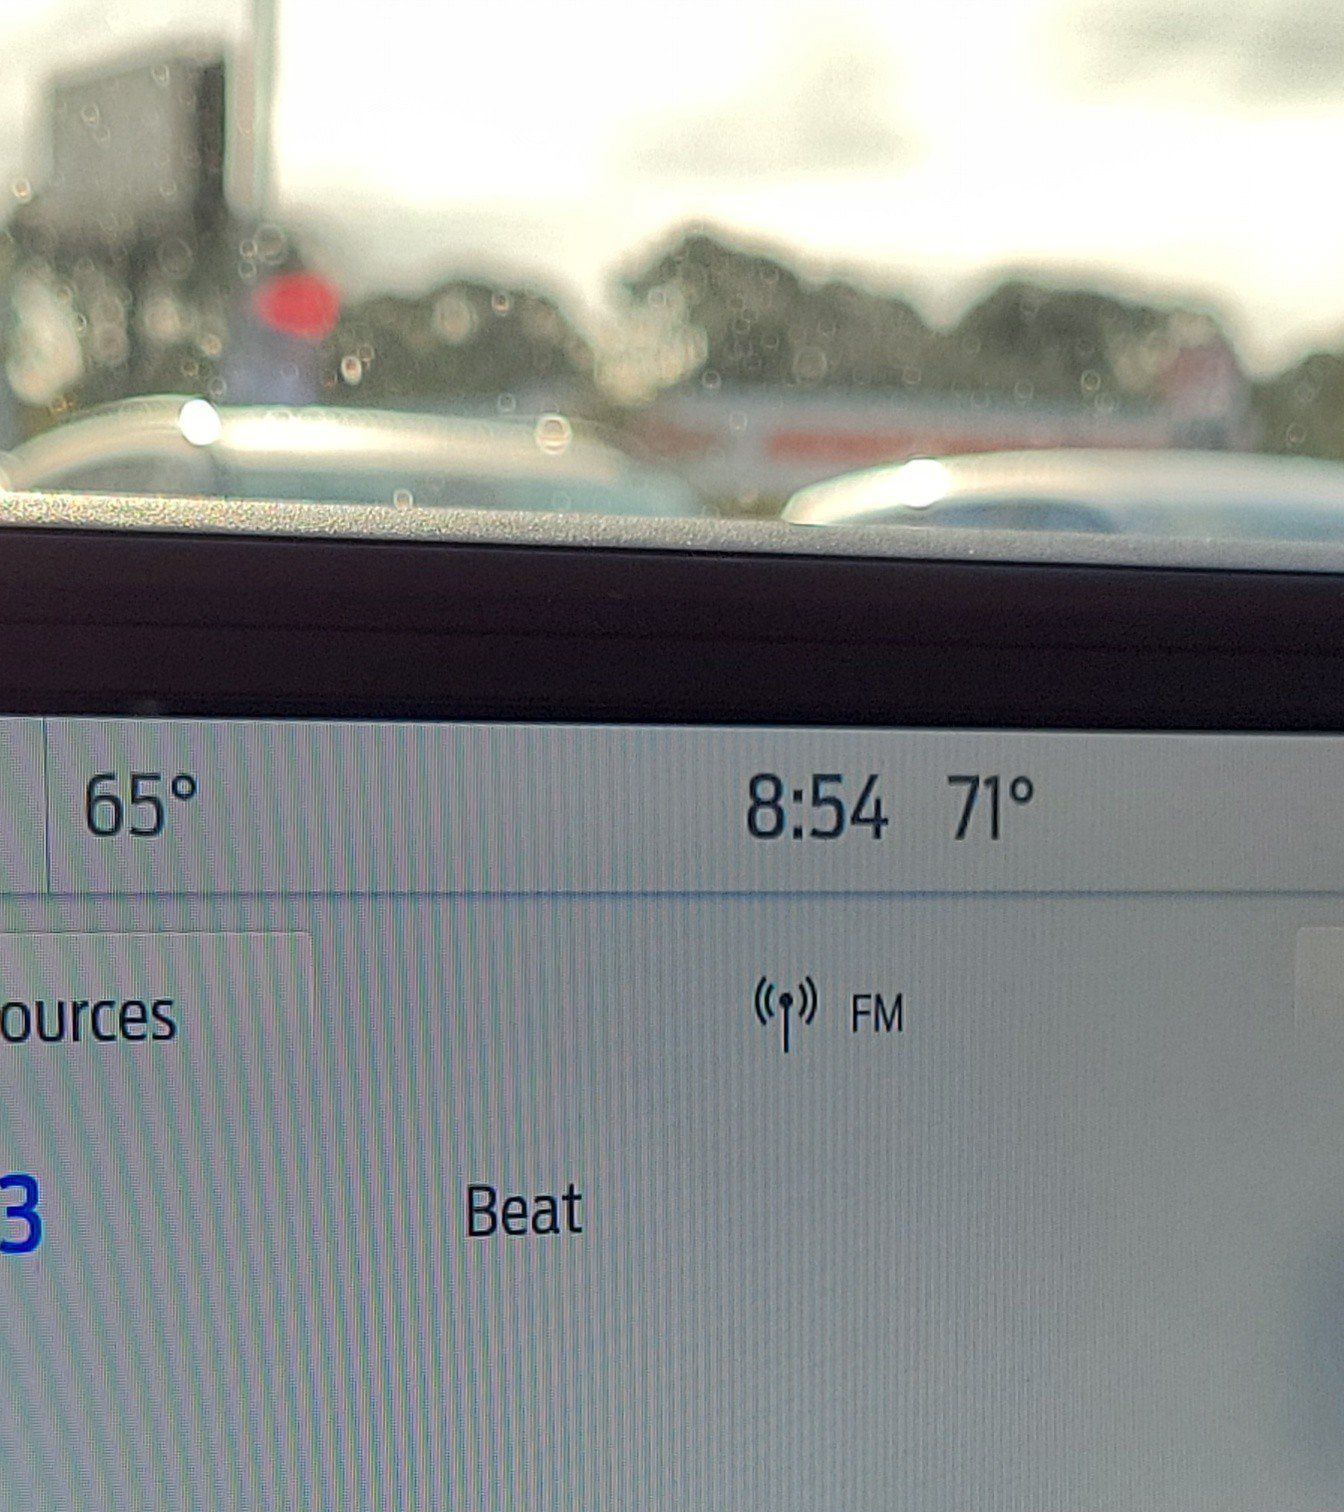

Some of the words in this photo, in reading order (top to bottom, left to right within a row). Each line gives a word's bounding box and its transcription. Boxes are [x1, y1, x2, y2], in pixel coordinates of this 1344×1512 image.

[85, 772, 198, 838] 65°
[746, 772, 889, 840] 8:54
[947, 774, 1035, 841] 71°
[852, 992, 904, 1033] FM
[467, 1183, 583, 1238] Beat
